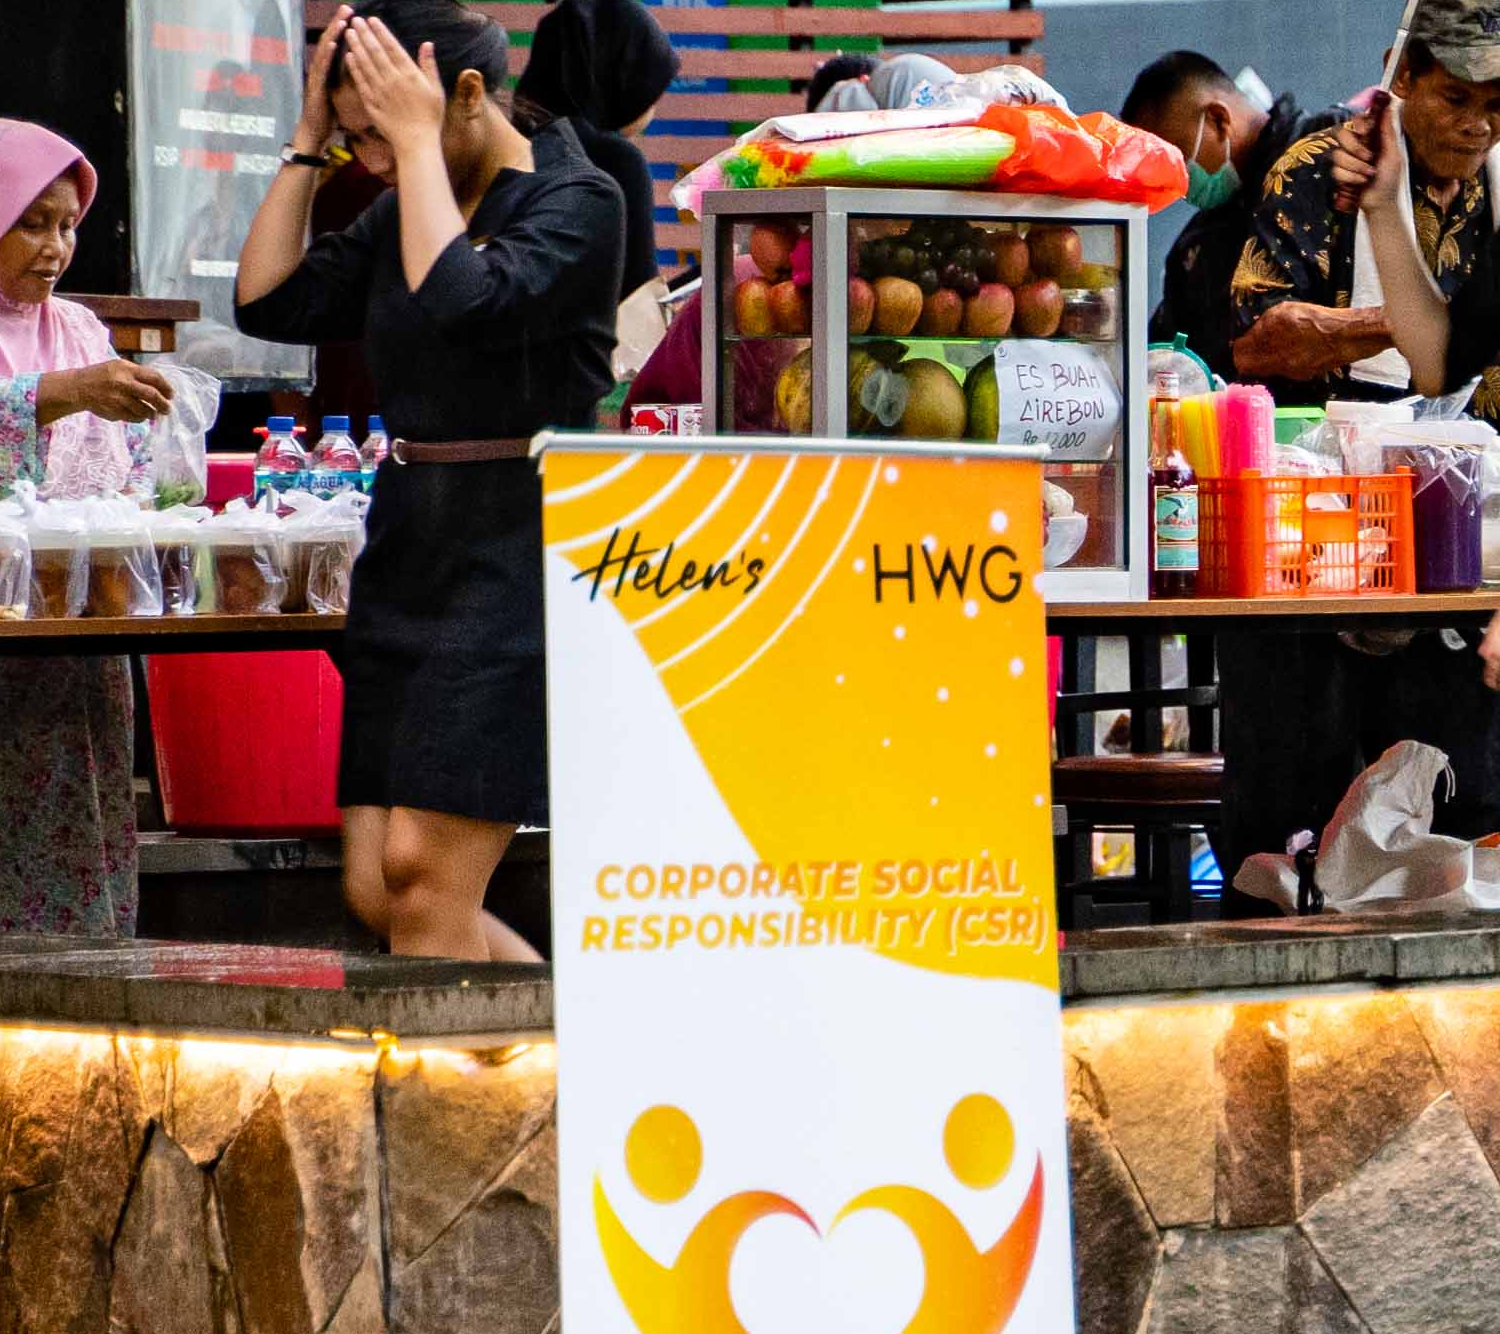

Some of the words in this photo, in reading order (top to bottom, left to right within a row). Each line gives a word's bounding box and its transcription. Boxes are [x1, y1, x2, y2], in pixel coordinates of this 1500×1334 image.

[1016, 364, 1045, 391] ES
[1050, 363, 1100, 392] BUAH
[571, 527, 766, 603] Helen's
[874, 543, 1023, 604] HWG
[595, 861, 860, 901] CORPORATE
[872, 858, 1024, 898] SOCIAL
[580, 909, 940, 952] RESPONSIBILITY
[944, 906, 1048, 956] (CSR)
